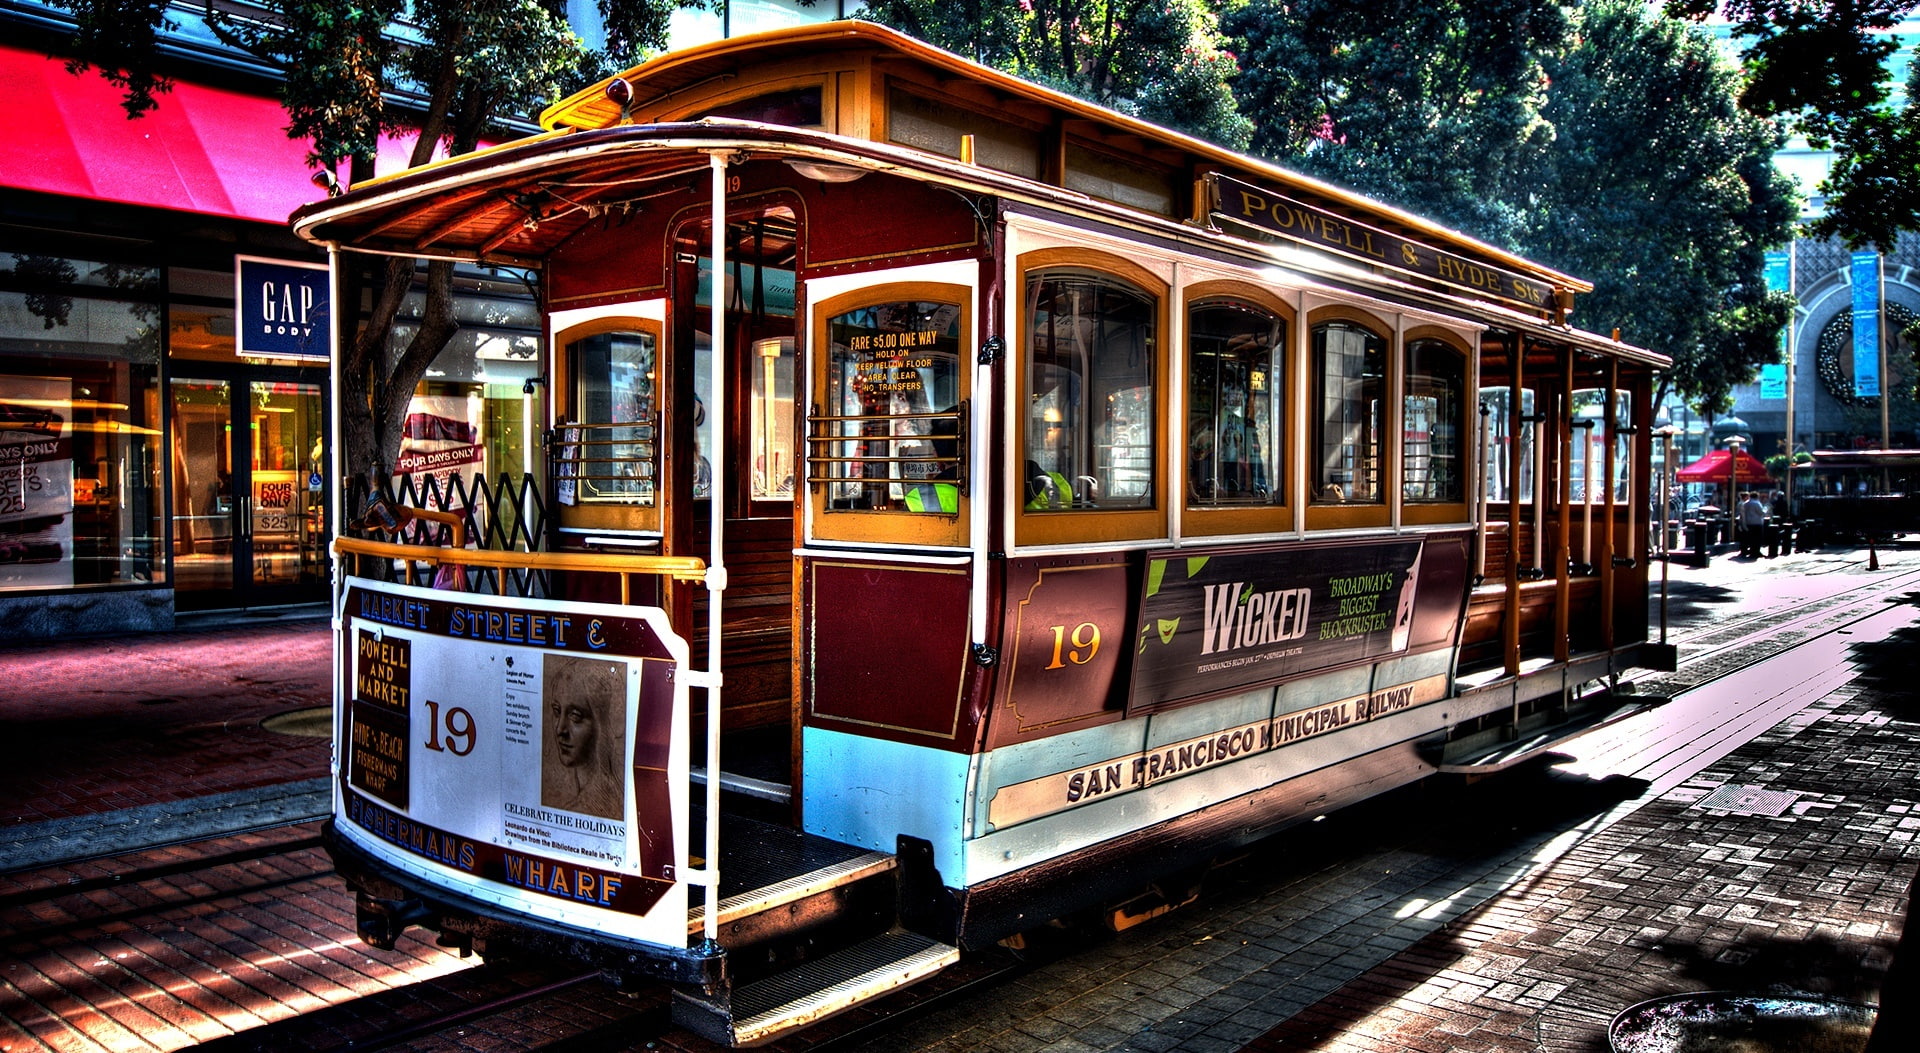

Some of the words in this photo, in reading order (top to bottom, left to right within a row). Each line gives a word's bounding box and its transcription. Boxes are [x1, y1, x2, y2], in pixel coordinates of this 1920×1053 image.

[727, 176, 740, 193] 19
[1239, 190, 1385, 258] POWELL
[1401, 242, 1421, 267] &
[1437, 255, 1502, 292] HYDE
[1512, 279, 1544, 303] Sts.
[262, 281, 313, 324] GAP
[264, 325, 311, 337] BODY
[851, 336, 870, 350] FARE
[873, 334, 896, 348] $5.00
[900, 332, 916, 346] ONE
[919, 331, 937, 345] WAY
[876, 350, 895, 358] HOLD
[898, 349, 909, 357] ON
[855, 362, 873, 371] KEEP
[876, 360, 904, 369] YELLOW
[906, 359, 932, 368] FLOOR
[864, 384, 874, 392] NO
[879, 382, 921, 391] TRANSFERS
[868, 373, 887, 382] AREA
[892, 371, 916, 380] CLEAR
[0, 446, 22, 458] AYS
[23, 442, 59, 456] ONLY
[401, 456, 426, 469] FOUR
[428, 452, 451, 464] DAYS
[452, 448, 475, 460] ONLY
[261, 483, 291, 491] FOUR
[261, 491, 291, 499] DAYS
[0, 496, 26, 514] 25
[260, 499, 291, 507] ONLY
[261, 516, 288, 529] $25
[1339, 594, 1379, 616] BIGGEST
[361, 592, 430, 629] MARKET
[450, 606, 571, 647] STREET
[360, 637, 408, 668] POWELL
[1044, 622, 1101, 670] 19
[370, 664, 394, 682] AND
[358, 673, 408, 707] MARKET
[425, 700, 477, 756] 19
[354, 721, 370, 748] HYDE
[380, 731, 403, 762] BEACH
[1066, 763, 1122, 803] SAN
[1131, 728, 1255, 785] FRANCISCO
[1259, 703, 1350, 748] MUNICIPAL
[1355, 686, 1414, 720] RAILWAY
[357, 749, 398, 781] FISHERMANS
[366, 769, 387, 792] WHARF
[504, 802, 553, 823] CELEBRATE
[554, 814, 573, 827] THE
[575, 818, 625, 837] HOLIDAYS
[505, 821, 528, 832] Leonardo
[529, 826, 535, 834] da
[535, 828, 551, 838] Vinci:
[352, 794, 476, 871] FISHERMANS
[503, 853, 622, 906] WHARF
[505, 829, 527, 842] Drawings
[528, 835, 541, 844] from
[542, 838, 551, 848] the
[551, 841, 580, 854] Biblioteca
[581, 847, 598, 858] Reale
[599, 851, 605, 859] in
